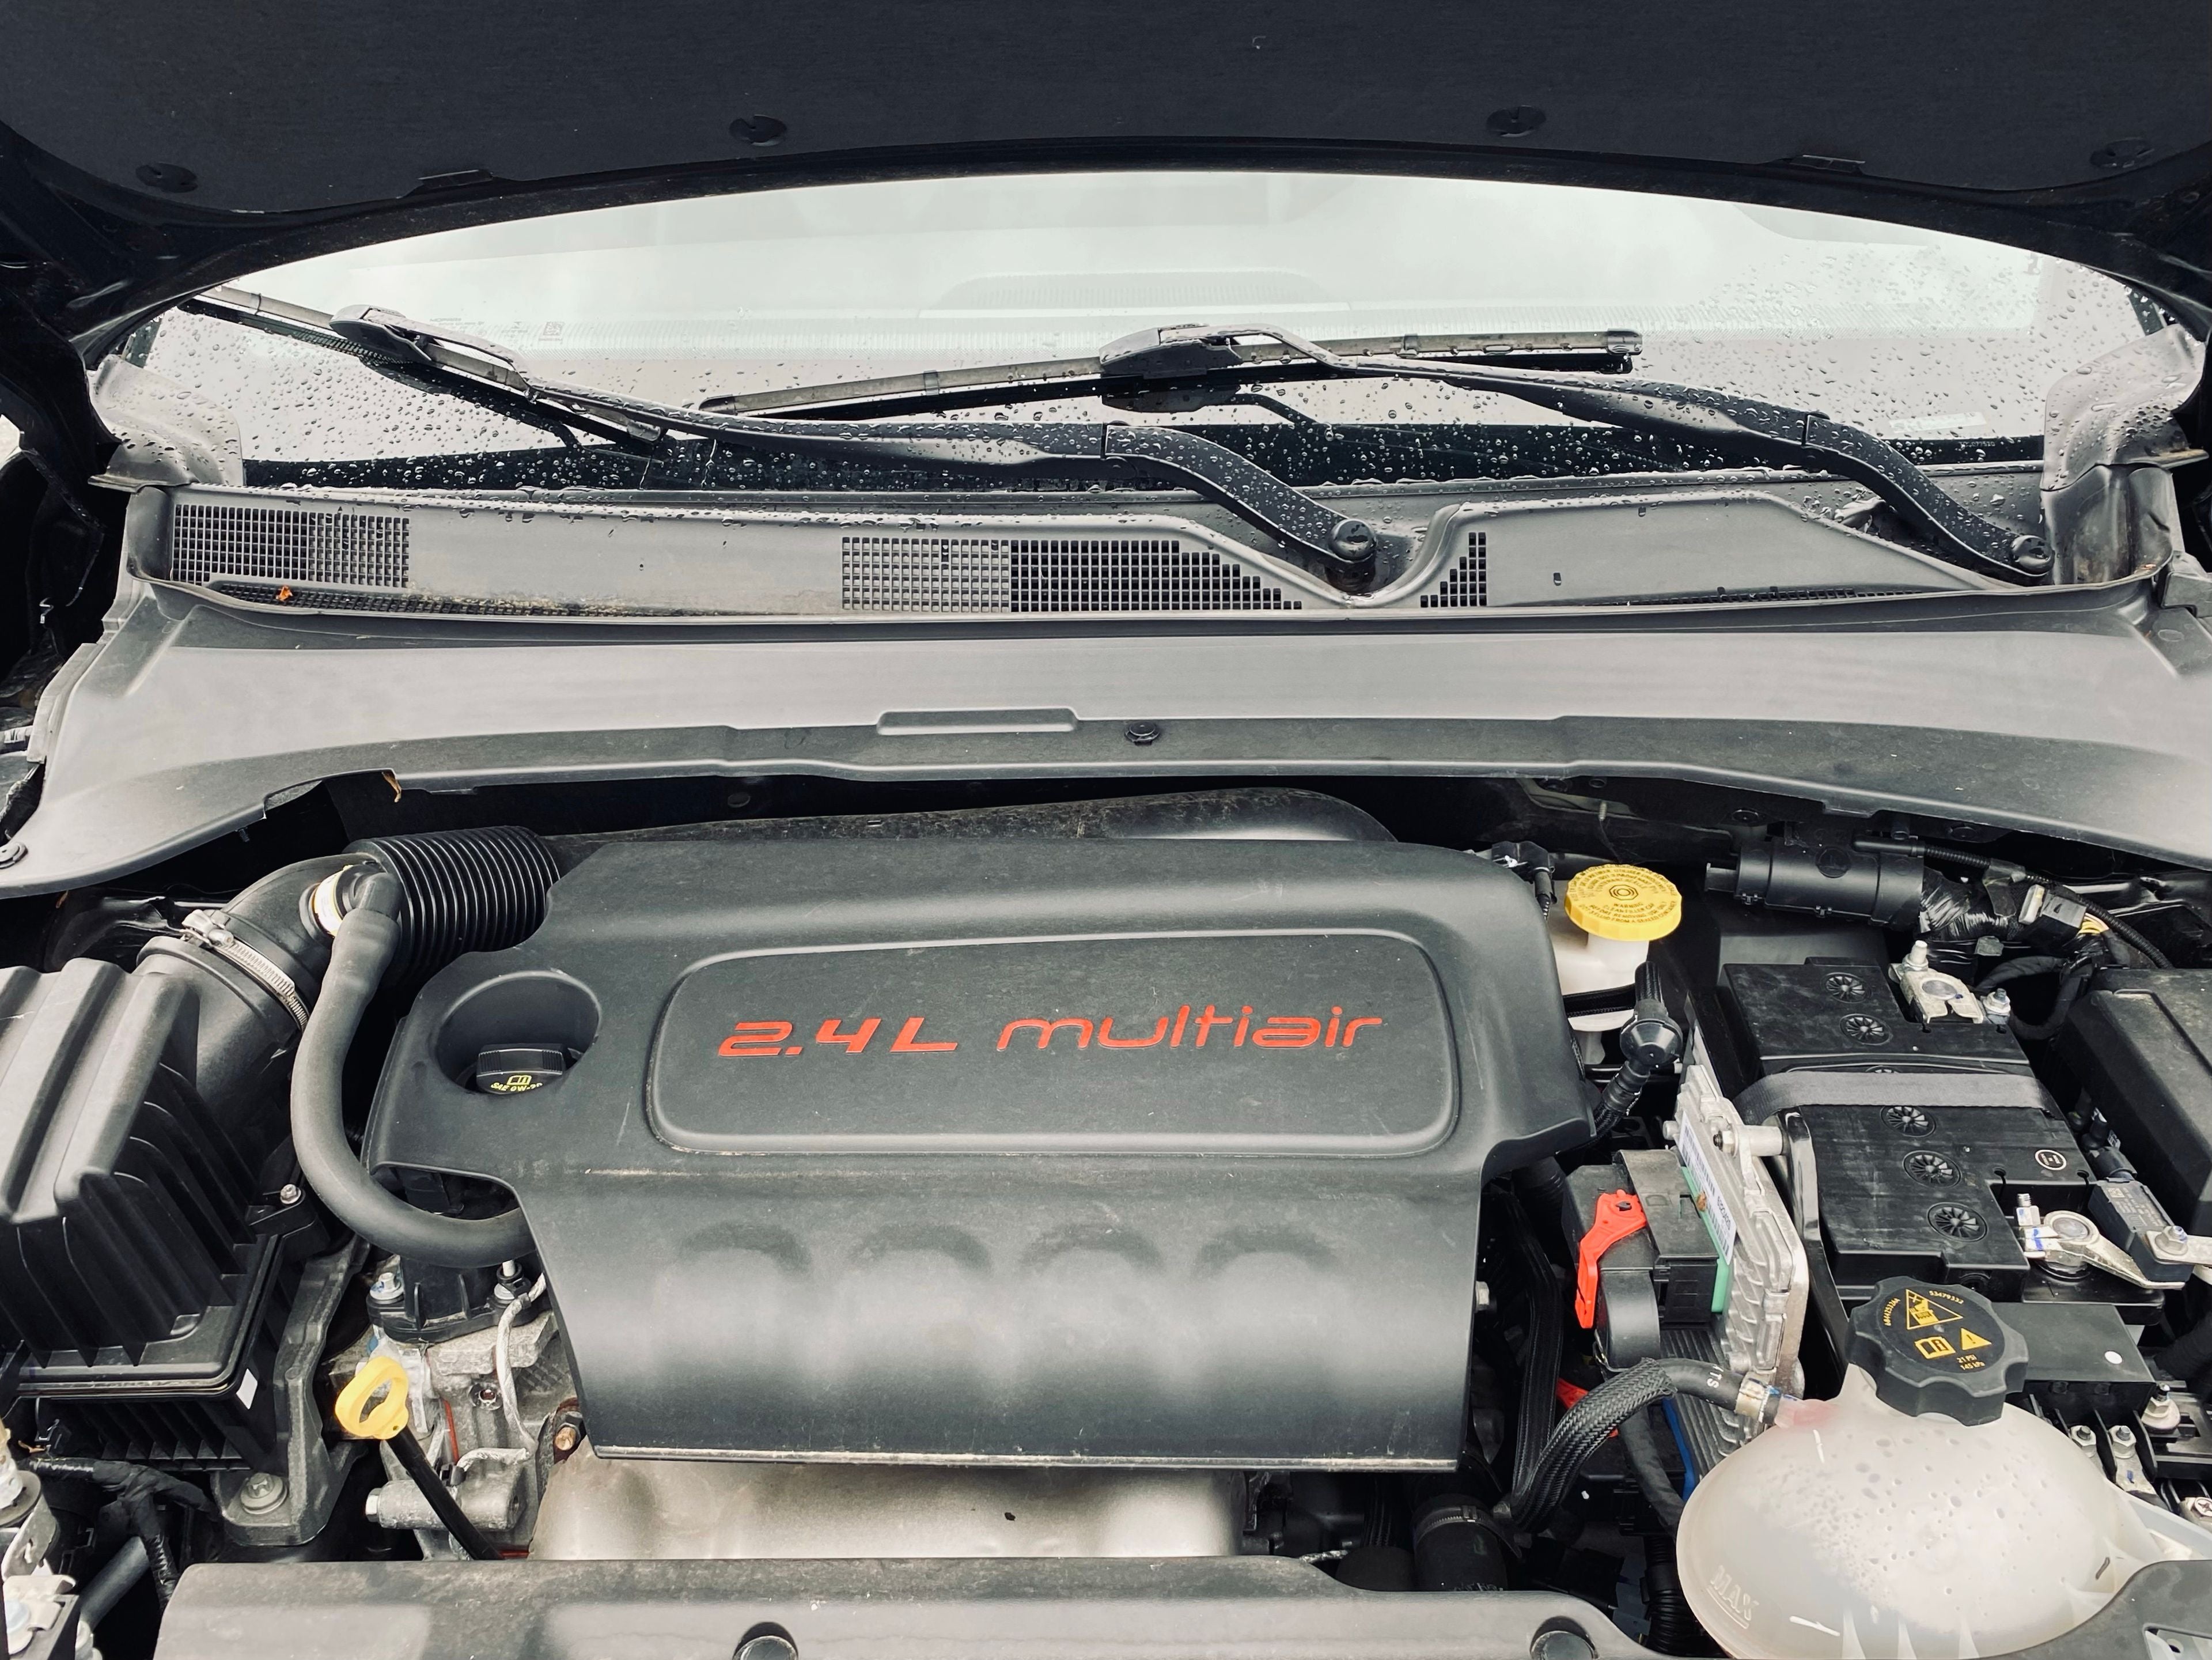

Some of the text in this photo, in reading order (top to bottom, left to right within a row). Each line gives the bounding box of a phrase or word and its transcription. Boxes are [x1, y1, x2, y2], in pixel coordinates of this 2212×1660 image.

[996, 1004, 1384, 1051] multiair
[490, 1082, 510, 1091] SAE
[1960, 1363, 1974, 1371] 145
[1710, 1564, 1760, 1621] MAX
